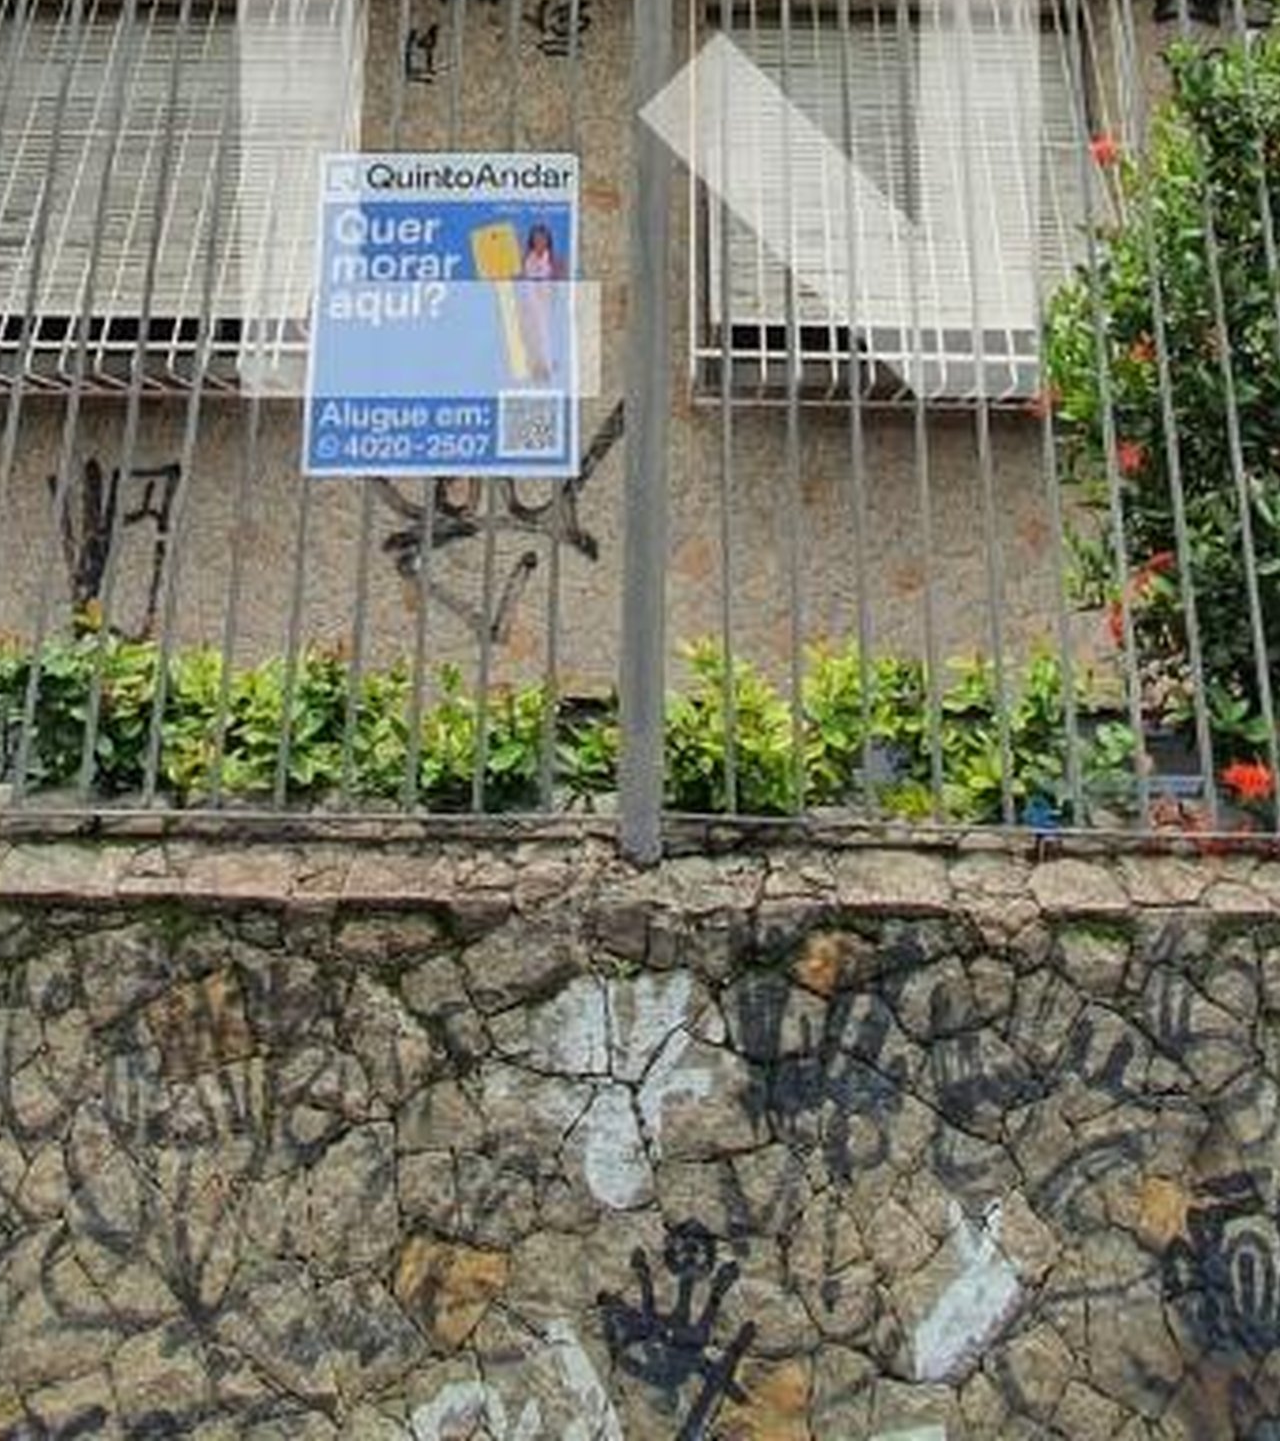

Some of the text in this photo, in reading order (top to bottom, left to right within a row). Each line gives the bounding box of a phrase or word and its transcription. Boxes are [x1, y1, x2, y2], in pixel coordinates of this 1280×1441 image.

[366, 163, 574, 190] QuintoAndar
[335, 209, 441, 245] Quer
[332, 253, 462, 283] morar
[329, 281, 447, 327] aqui?
[319, 401, 491, 433] Alugue em:
[343, 433, 491, 458] 4020-2507
